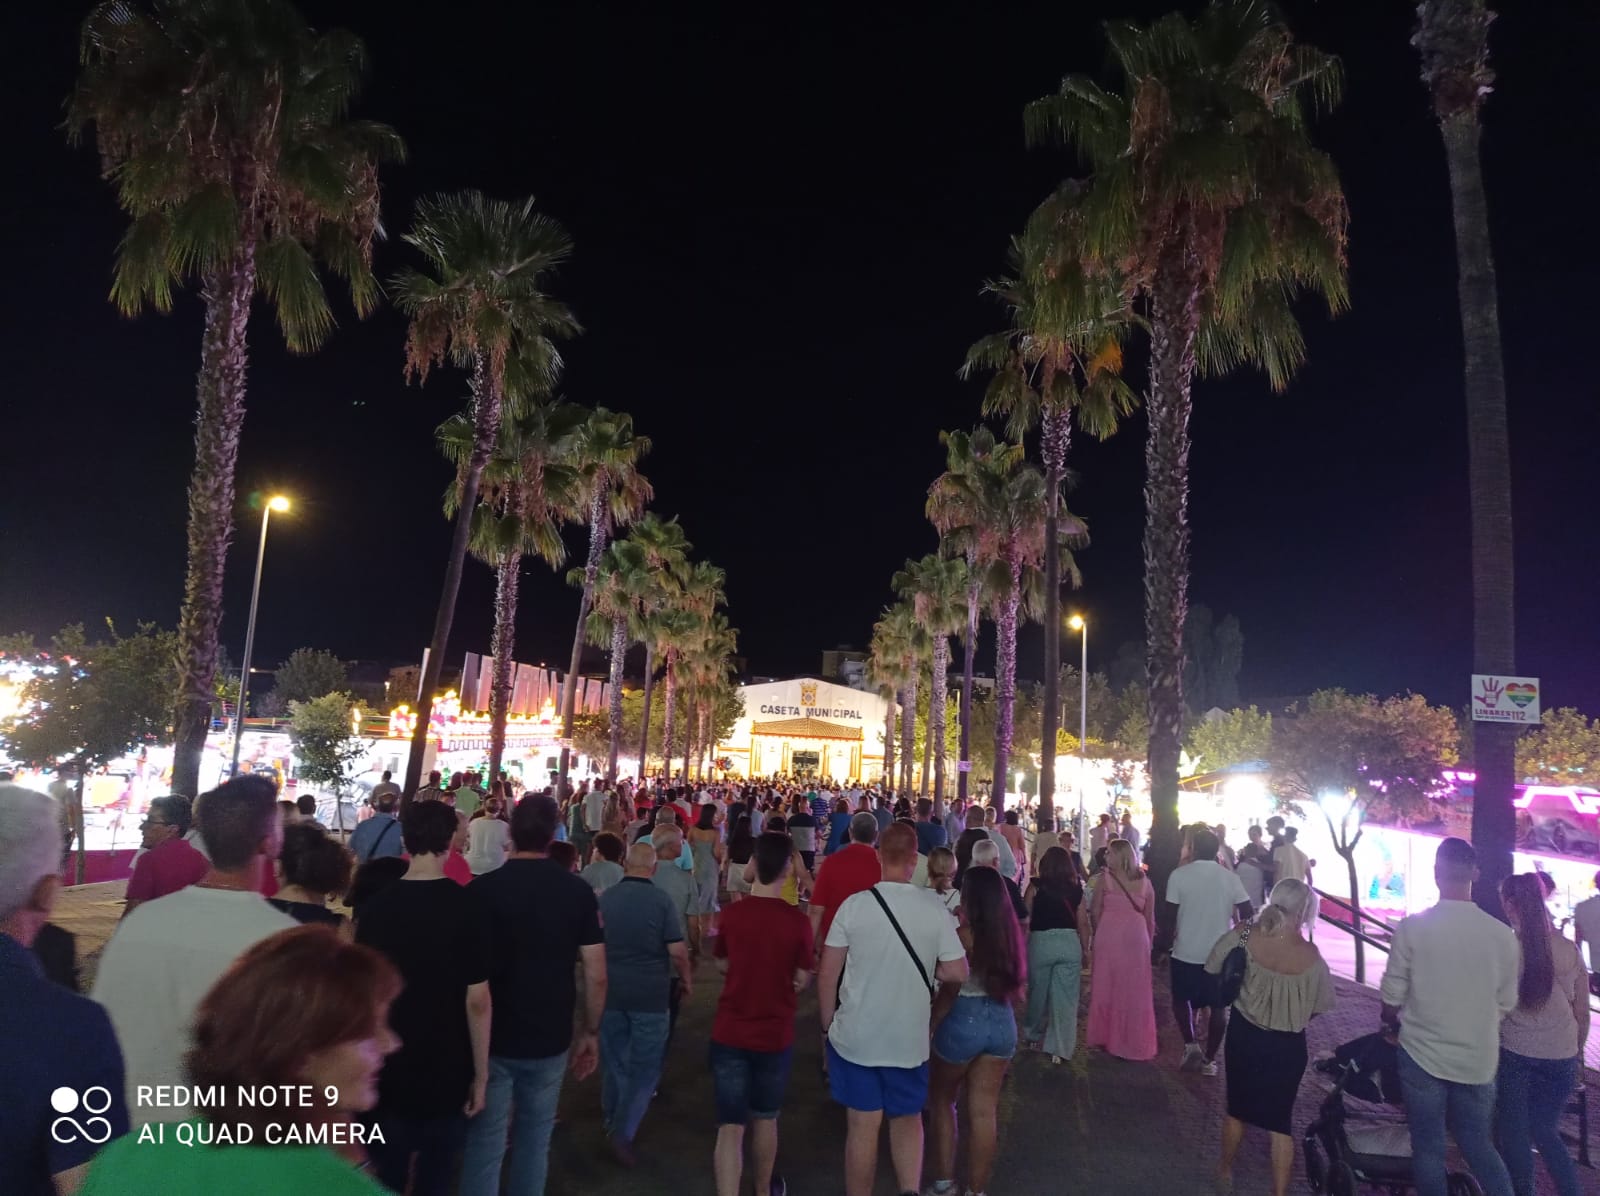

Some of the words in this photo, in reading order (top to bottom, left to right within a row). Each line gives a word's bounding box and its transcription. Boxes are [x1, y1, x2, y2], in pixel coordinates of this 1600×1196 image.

[760, 704, 800, 716] CASETA
[806, 707, 863, 719] MUNICIPAL
[1474, 708, 1512, 717] LINARES
[1511, 711, 1526, 721] 112
